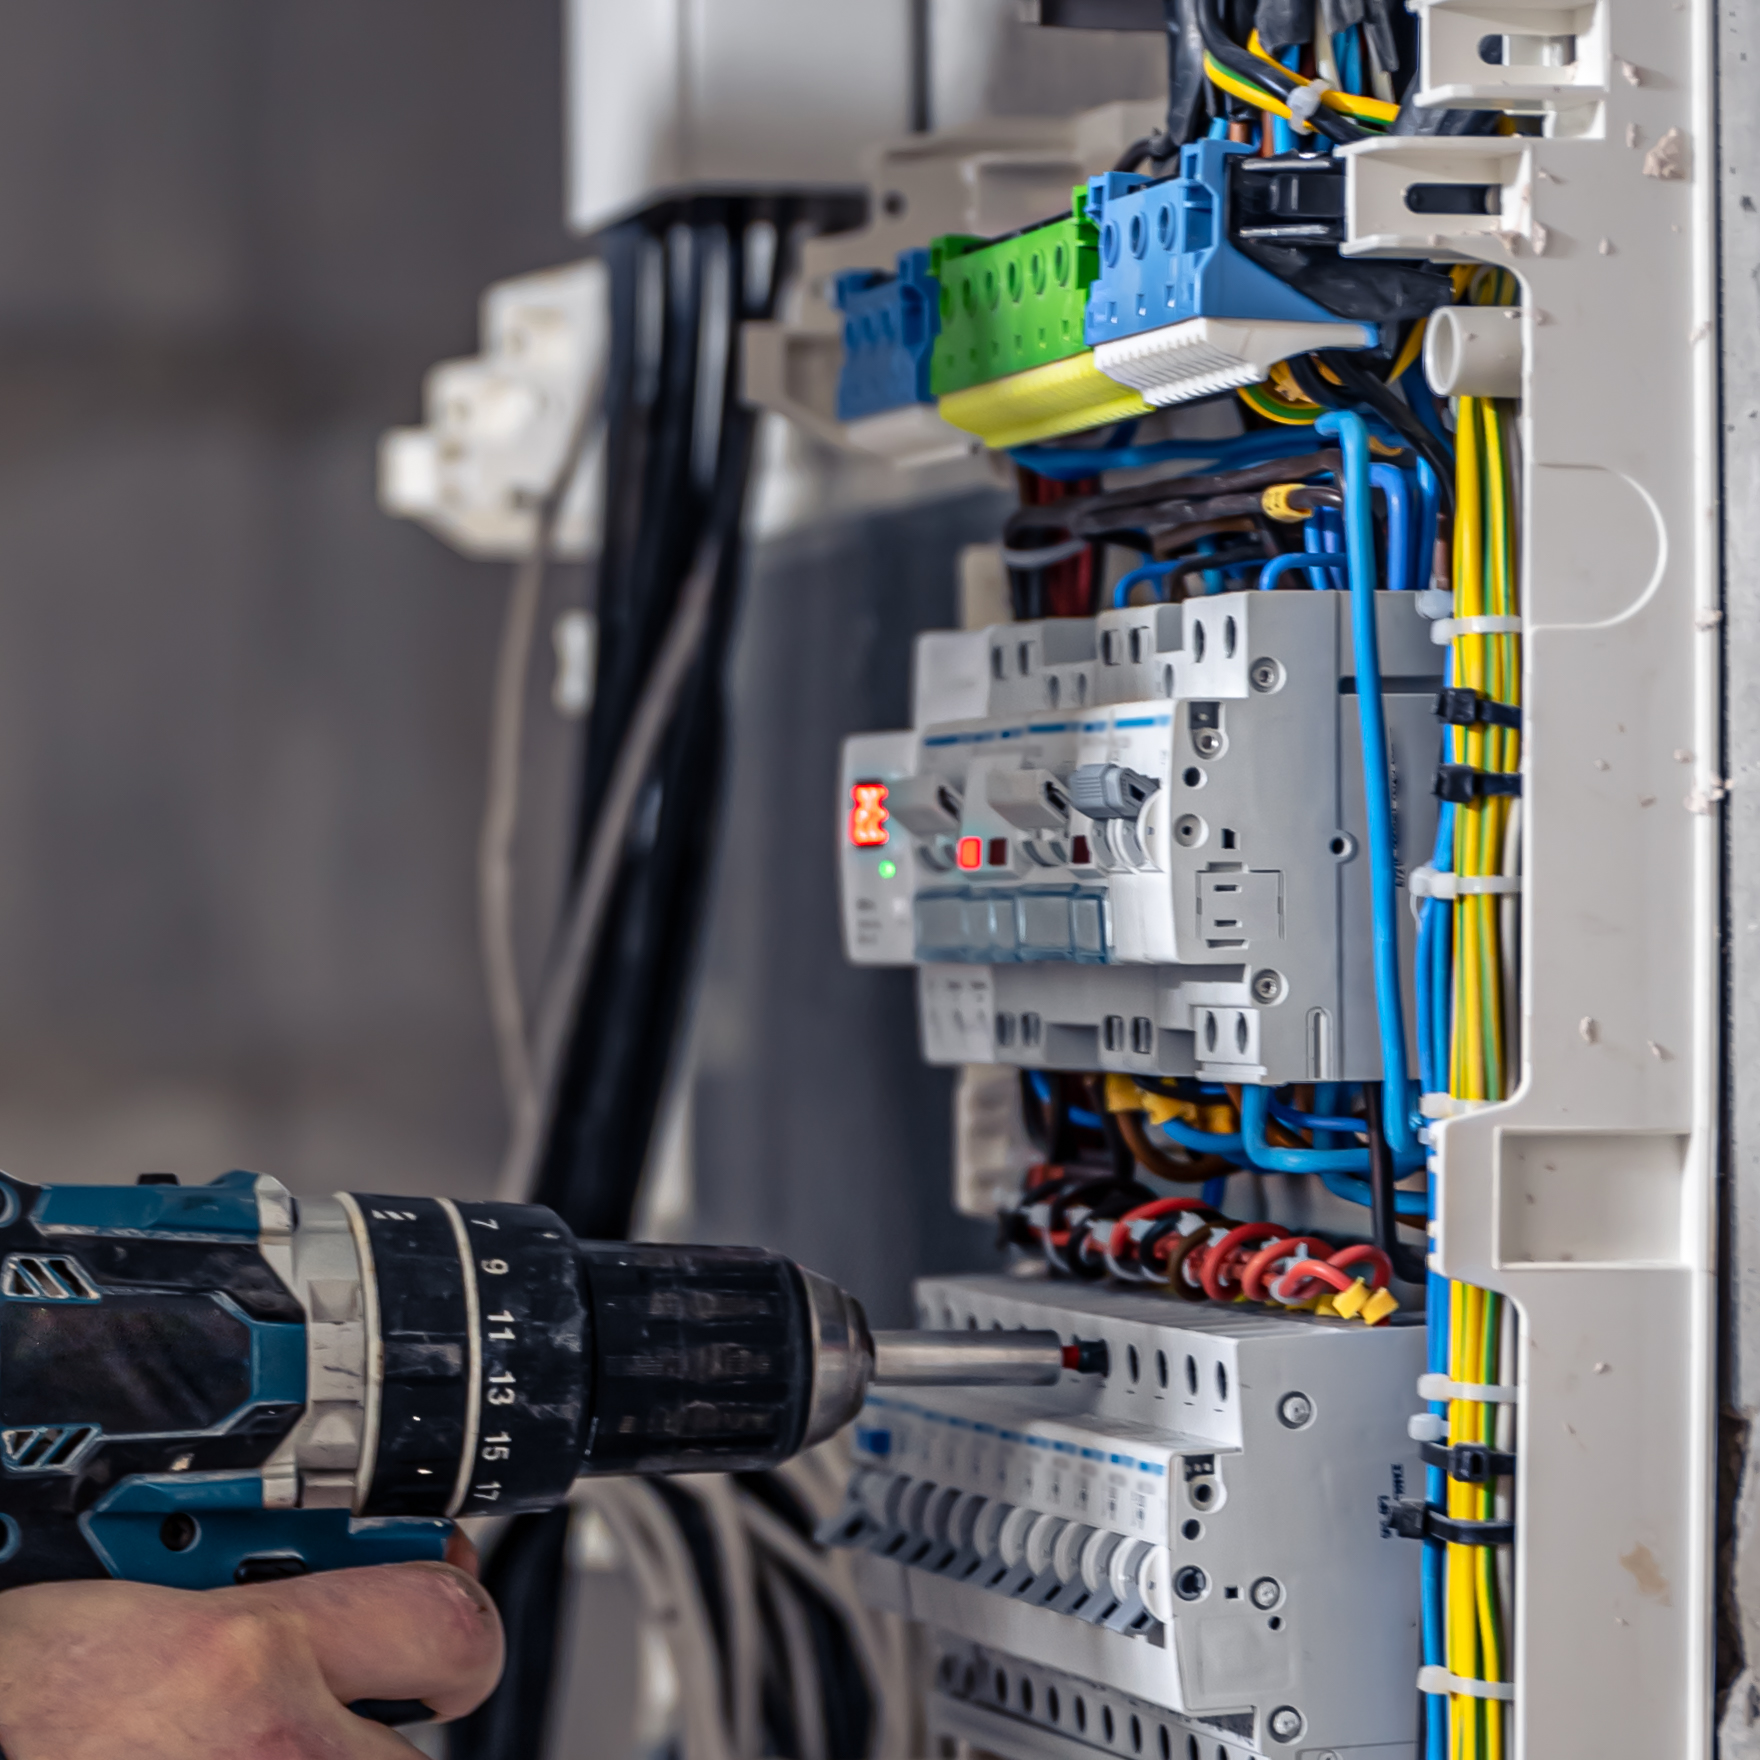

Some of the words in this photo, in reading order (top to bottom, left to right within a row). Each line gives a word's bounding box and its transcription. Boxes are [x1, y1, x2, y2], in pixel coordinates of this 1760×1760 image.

[470, 1218, 499, 1230] 7
[480, 1257, 510, 1275] 9
[487, 1309, 516, 1342] 11
[487, 1371, 517, 1406] 13
[481, 1431, 512, 1462] 15
[473, 1481, 502, 1500] 17
